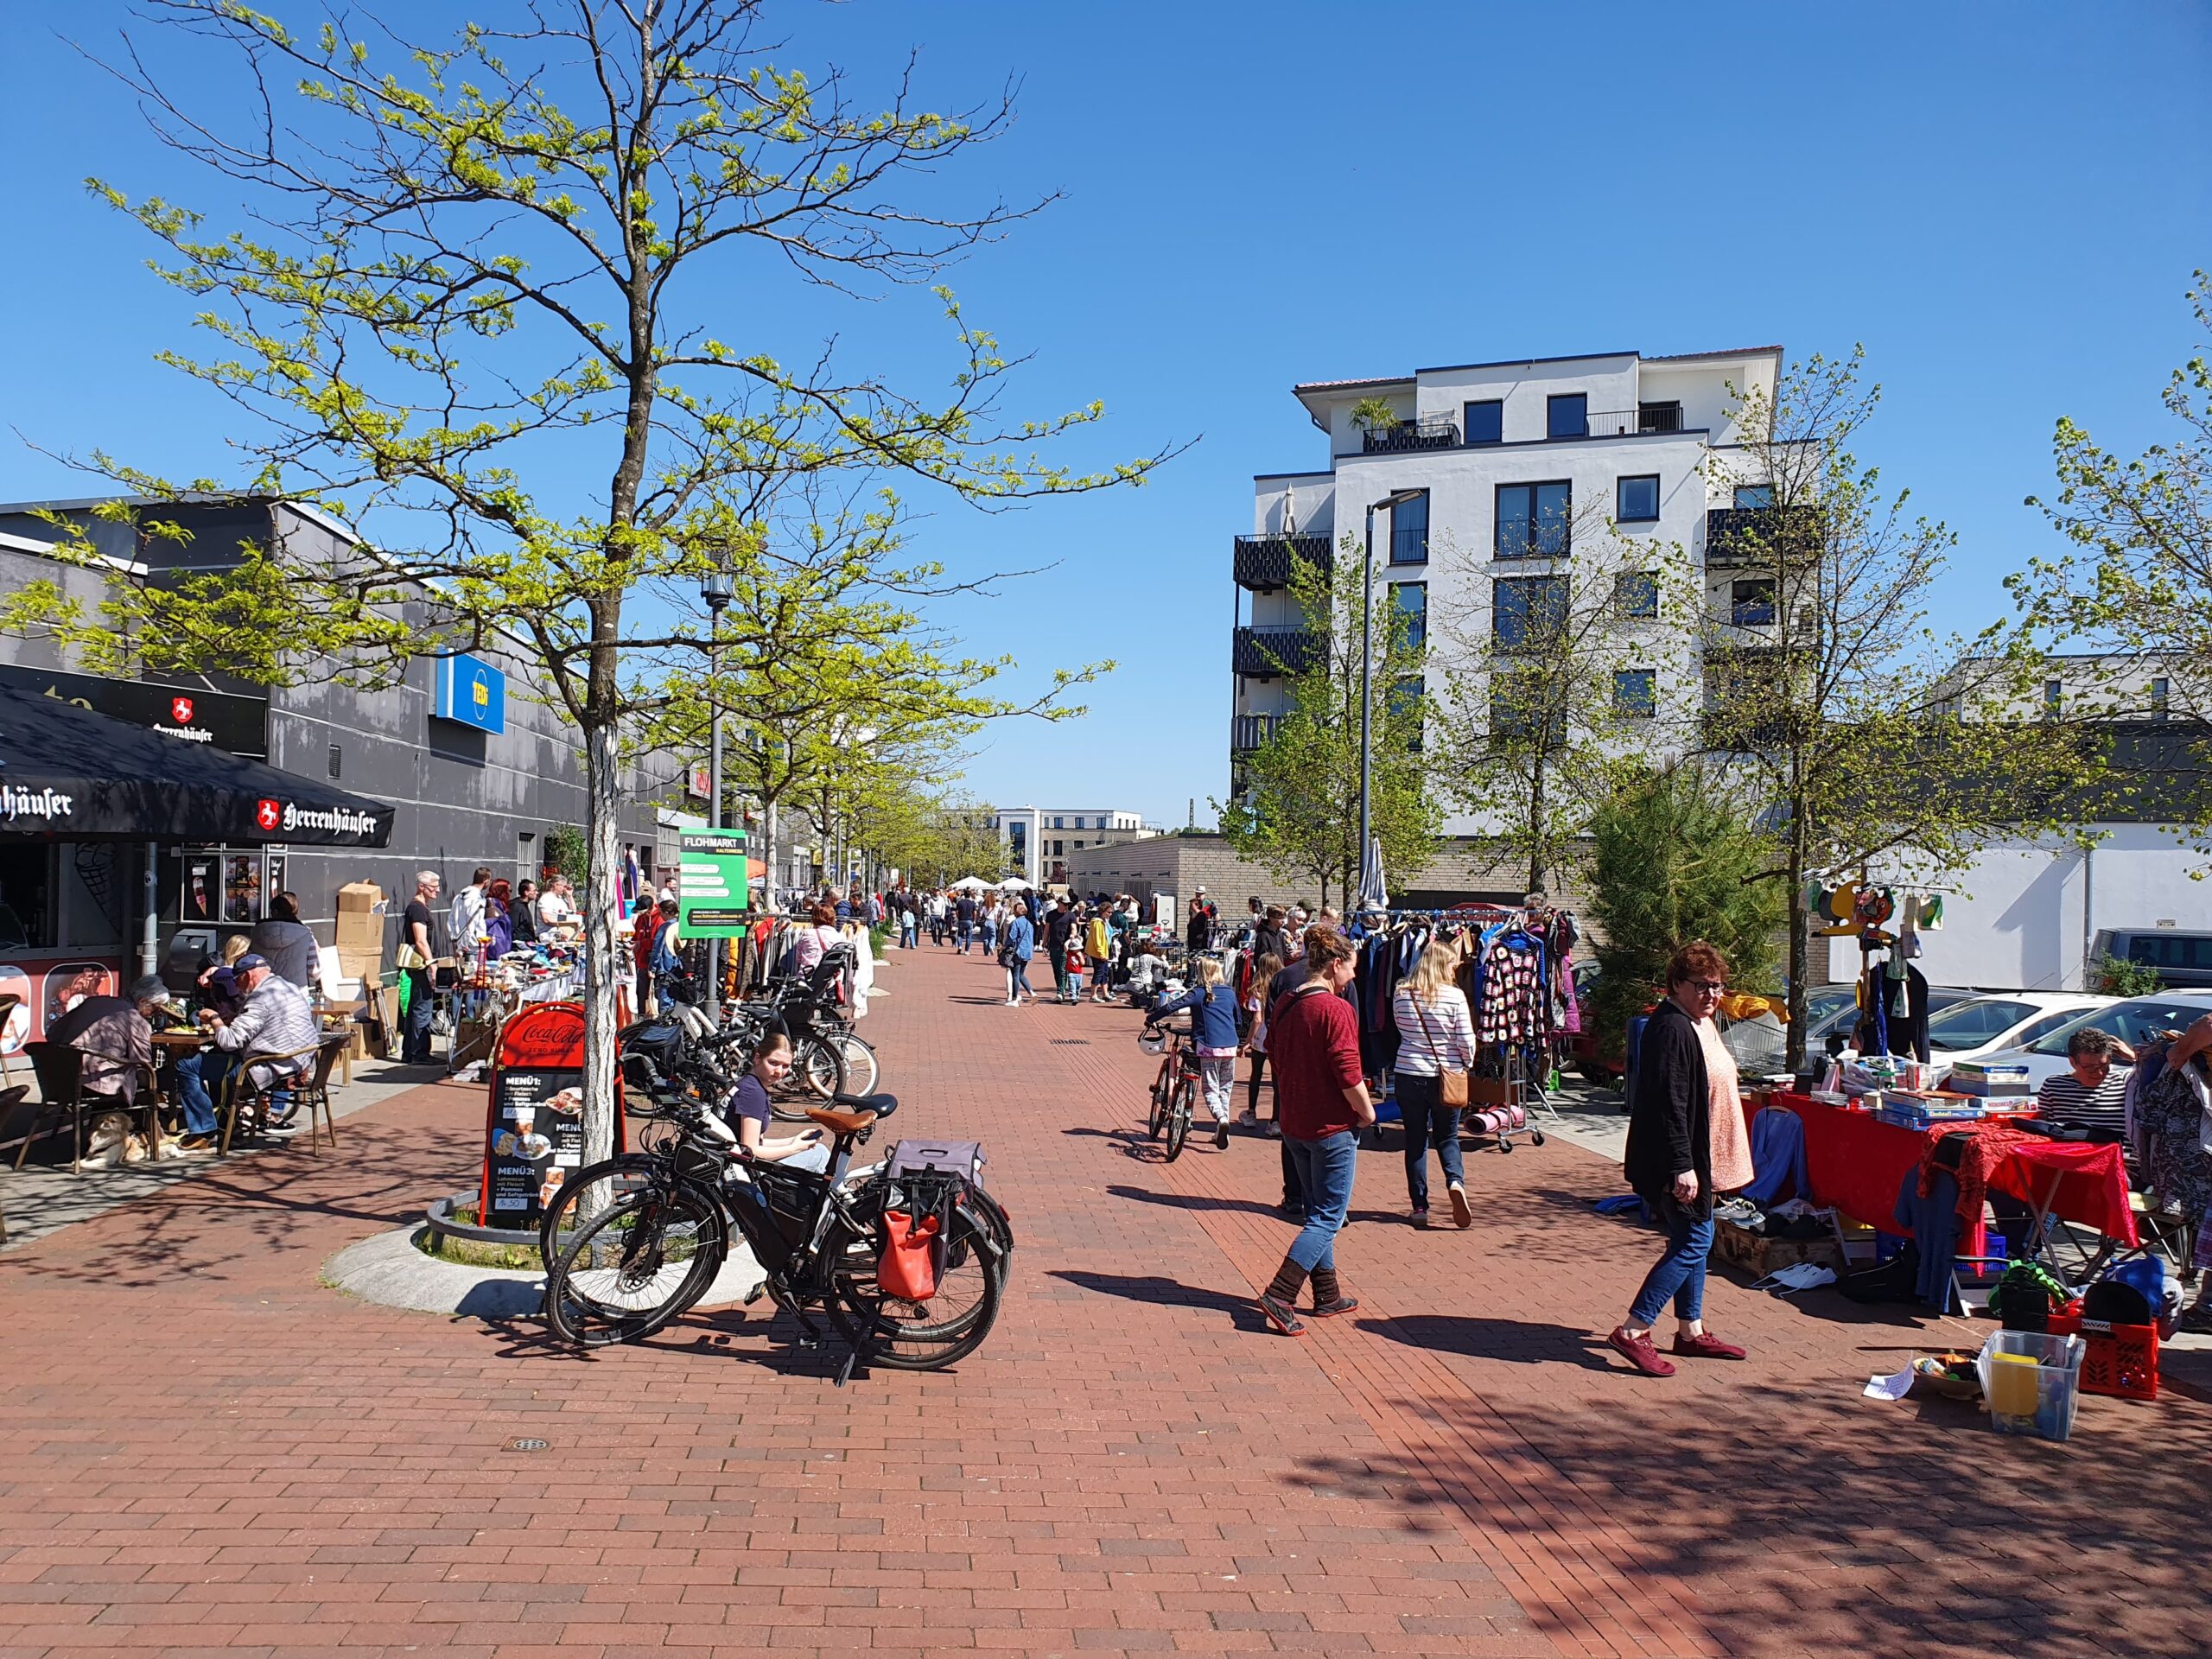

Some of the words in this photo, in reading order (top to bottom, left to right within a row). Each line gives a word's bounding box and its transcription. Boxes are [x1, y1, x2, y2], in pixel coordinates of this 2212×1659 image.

[0, 785, 73, 822] häuser
[684, 837, 738, 849] FLOHMARKT
[505, 1075, 542, 1086] MENÜ1:
[497, 1165, 536, 1176] MENÜ3:
